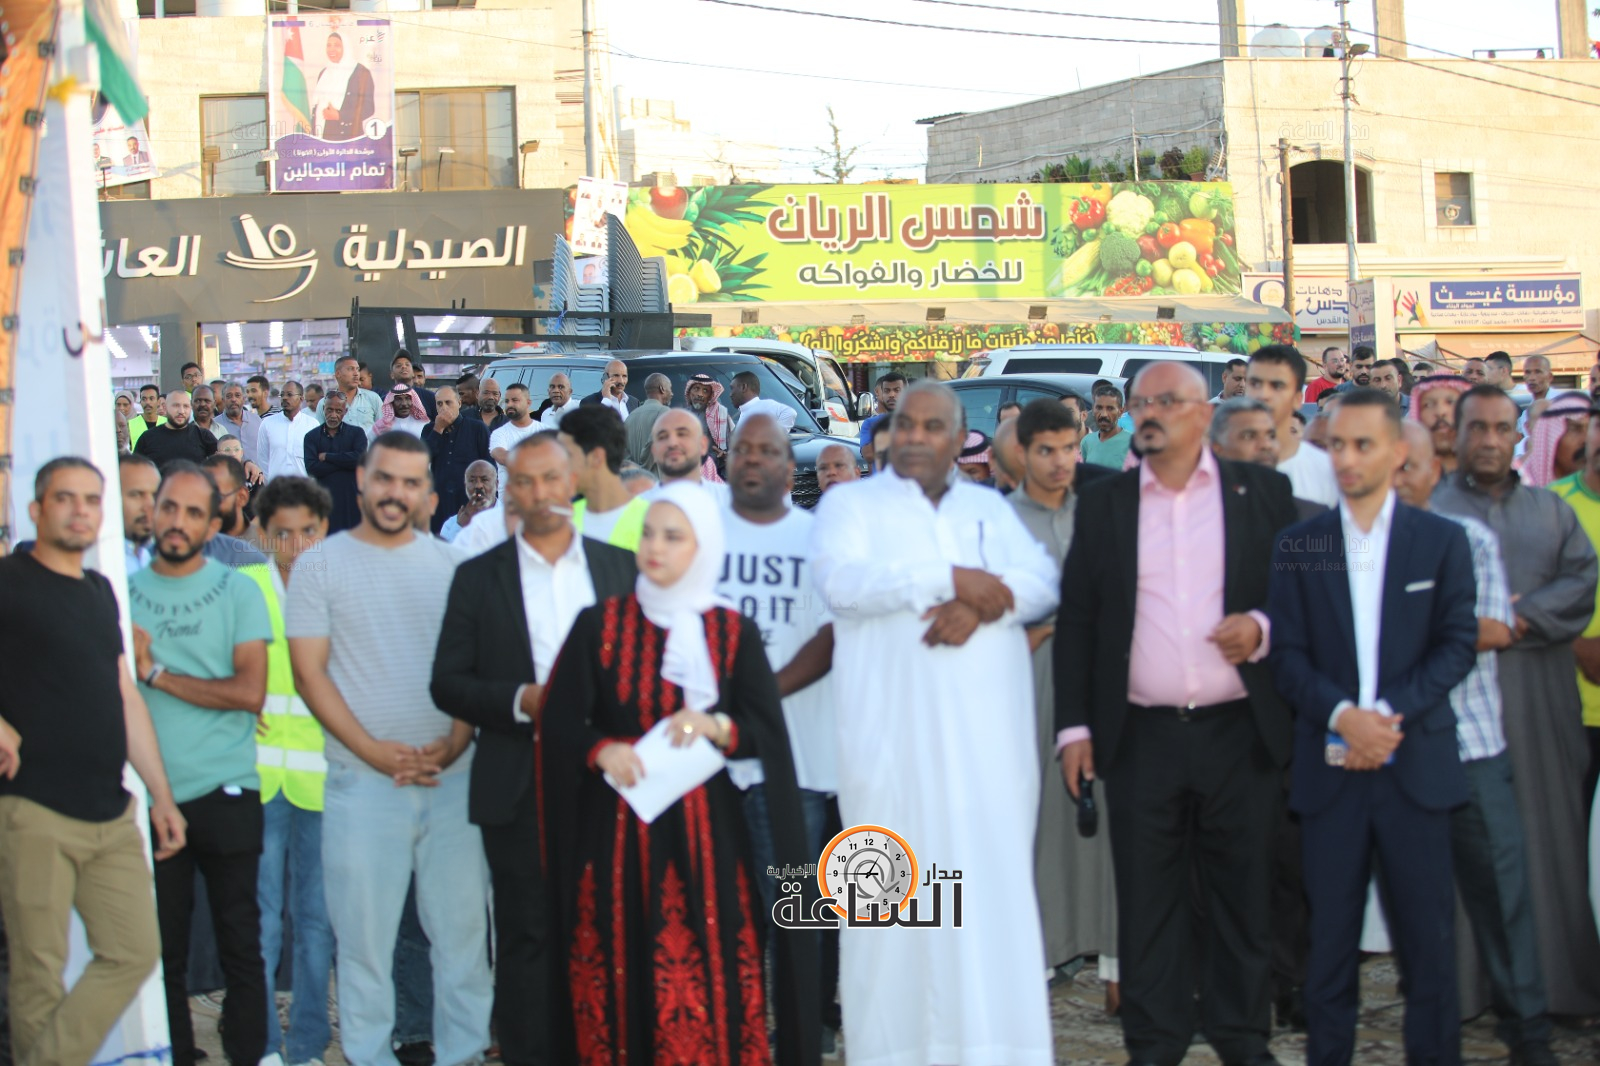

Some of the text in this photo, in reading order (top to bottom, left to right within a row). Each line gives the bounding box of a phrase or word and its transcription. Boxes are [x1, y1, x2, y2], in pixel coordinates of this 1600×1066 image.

[370, 122, 379, 136] 1
[284, 162, 386, 182] تمام العجالين
[768, 190, 1044, 250] شمس الريان
[342, 224, 527, 281] الصيدلية
[799, 261, 1022, 288] للخضار والفواكه
[1296, 286, 1342, 296] دهانات
[1506, 284, 1575, 304] مؤسسة
[1316, 316, 1341, 326] القدس
[718, 553, 805, 588] JUST
[770, 596, 795, 622] IT
[155, 619, 203, 639] Trend
